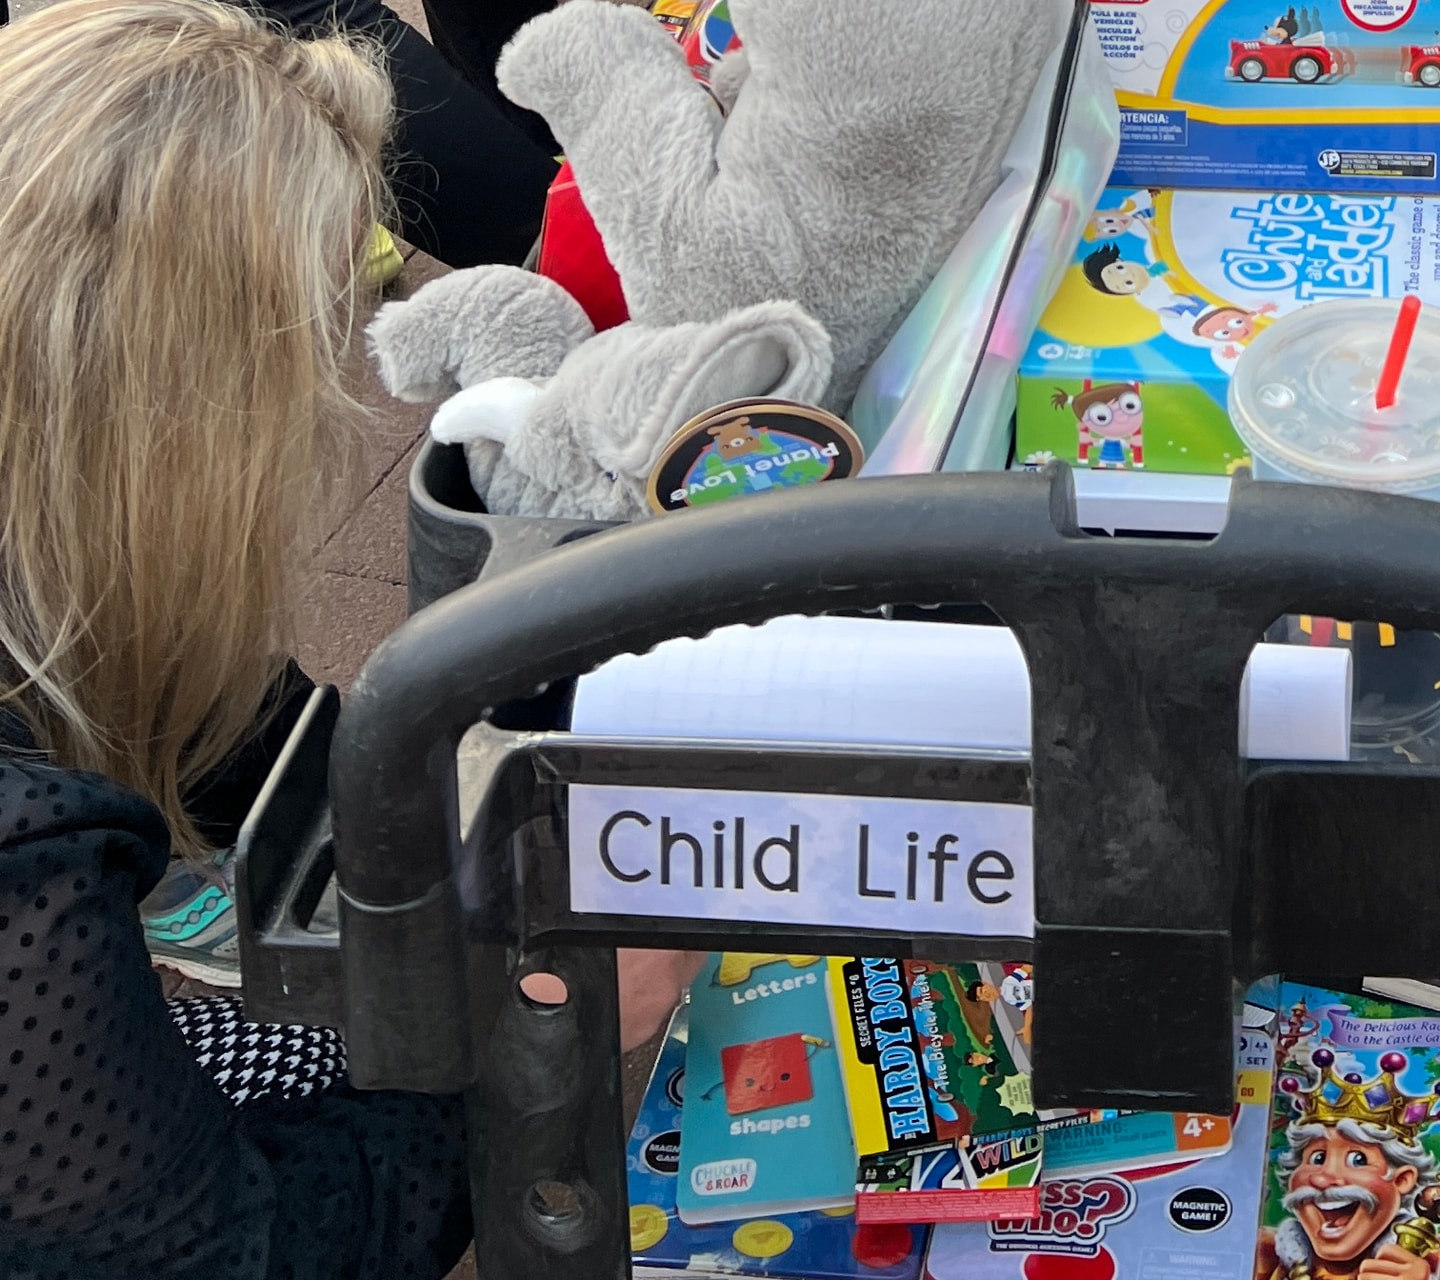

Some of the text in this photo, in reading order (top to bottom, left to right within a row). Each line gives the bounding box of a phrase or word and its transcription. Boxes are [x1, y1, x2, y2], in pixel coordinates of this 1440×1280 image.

[1411, 206, 1426, 234] game
[1221, 193, 1325, 290] Chute
[1404, 235, 1422, 271] classic
[1306, 257, 1329, 282] and
[1404, 272, 1420, 291] The
[744, 442, 840, 478] Planet
[670, 470, 738, 504] Love
[599, 809, 1016, 905] Child Life
[732, 972, 818, 1006] Letters
[851, 986, 867, 1014] FILES
[855, 1015, 873, 1048] SECRET
[918, 974, 950, 1091] The Bicycle Thief
[1341, 1020, 1361, 1032] The
[1365, 1020, 1417, 1033] Delicious
[1348, 1034, 1360, 1045] to
[1363, 1034, 1382, 1045] the
[1386, 1033, 1422, 1045] Castle
[1246, 1056, 1268, 1066] SET
[874, 1025, 931, 1140] HARDY
[730, 1114, 812, 1135] shapes
[977, 1116, 1089, 1145] HARDY BOYS SECRET FILES
[1182, 1117, 1216, 1137] 4+
[976, 1133, 1042, 1170] WILD
[715, 1173, 748, 1190] ROAR
[1173, 1200, 1226, 1212] MAGNETIC
